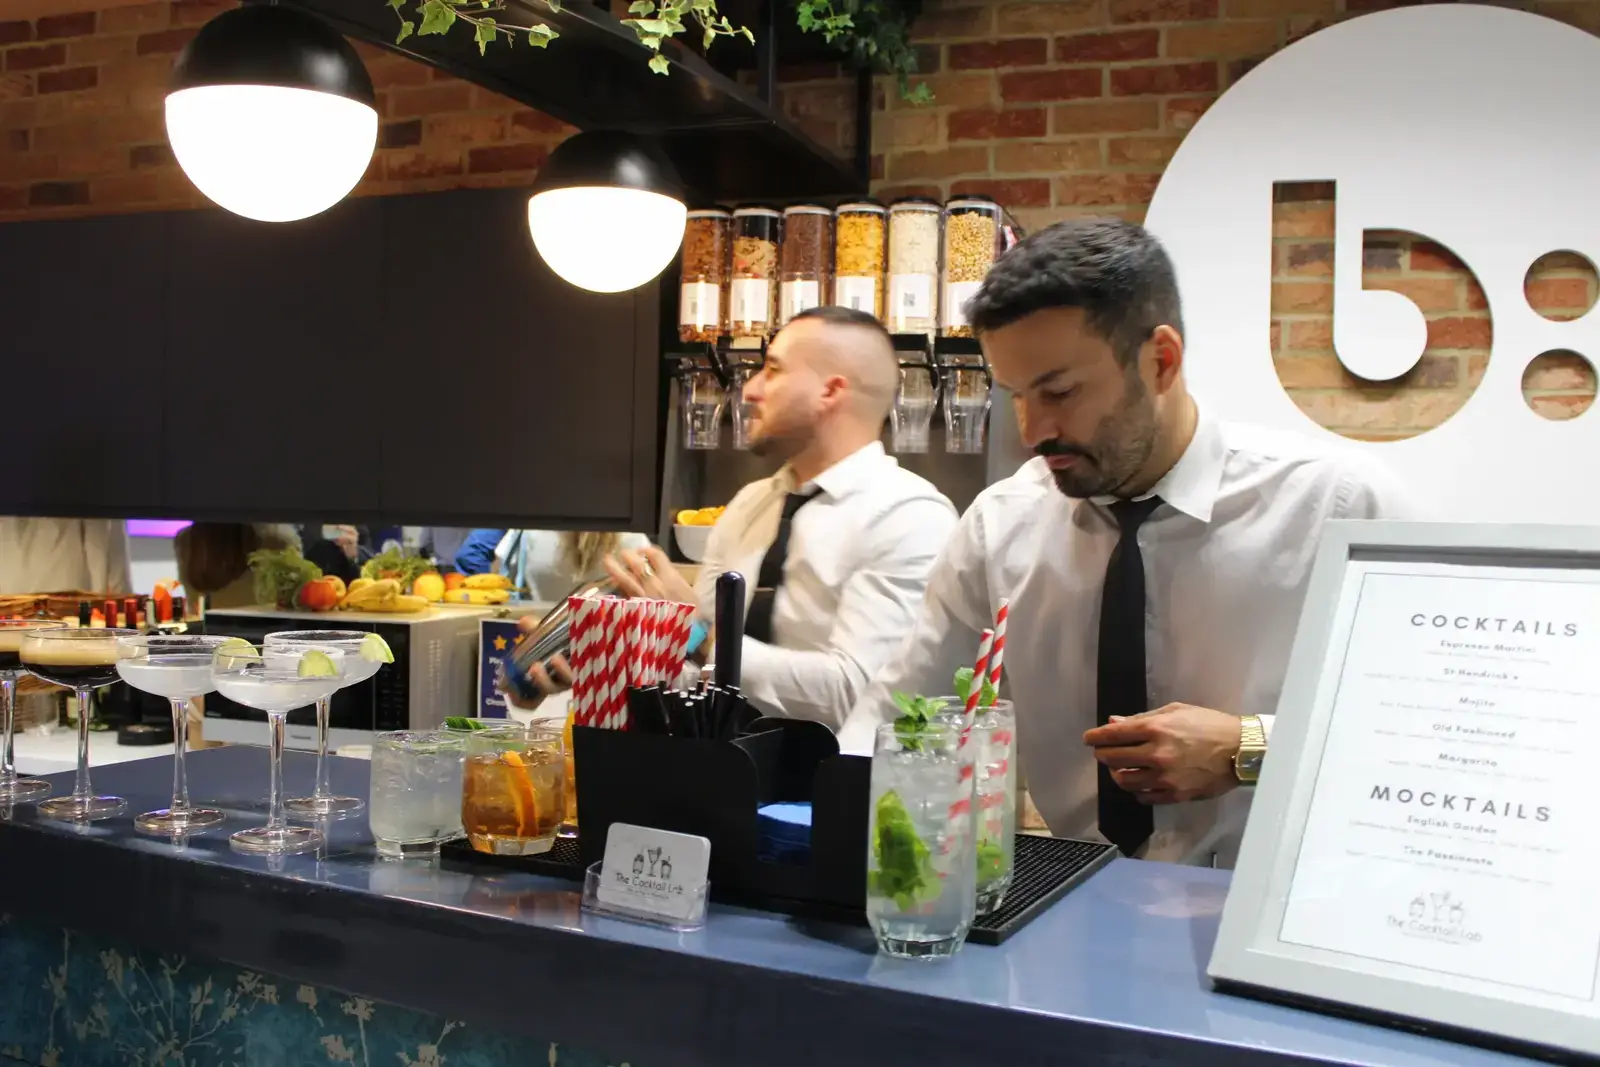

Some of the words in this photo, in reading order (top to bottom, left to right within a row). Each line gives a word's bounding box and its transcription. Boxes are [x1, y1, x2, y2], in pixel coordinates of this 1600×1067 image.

[1410, 613, 1579, 637] COCKTAILS
[1432, 723, 1453, 733] Old
[1370, 785, 1552, 822] MOCKTAILS
[1407, 815, 1449, 829] English
